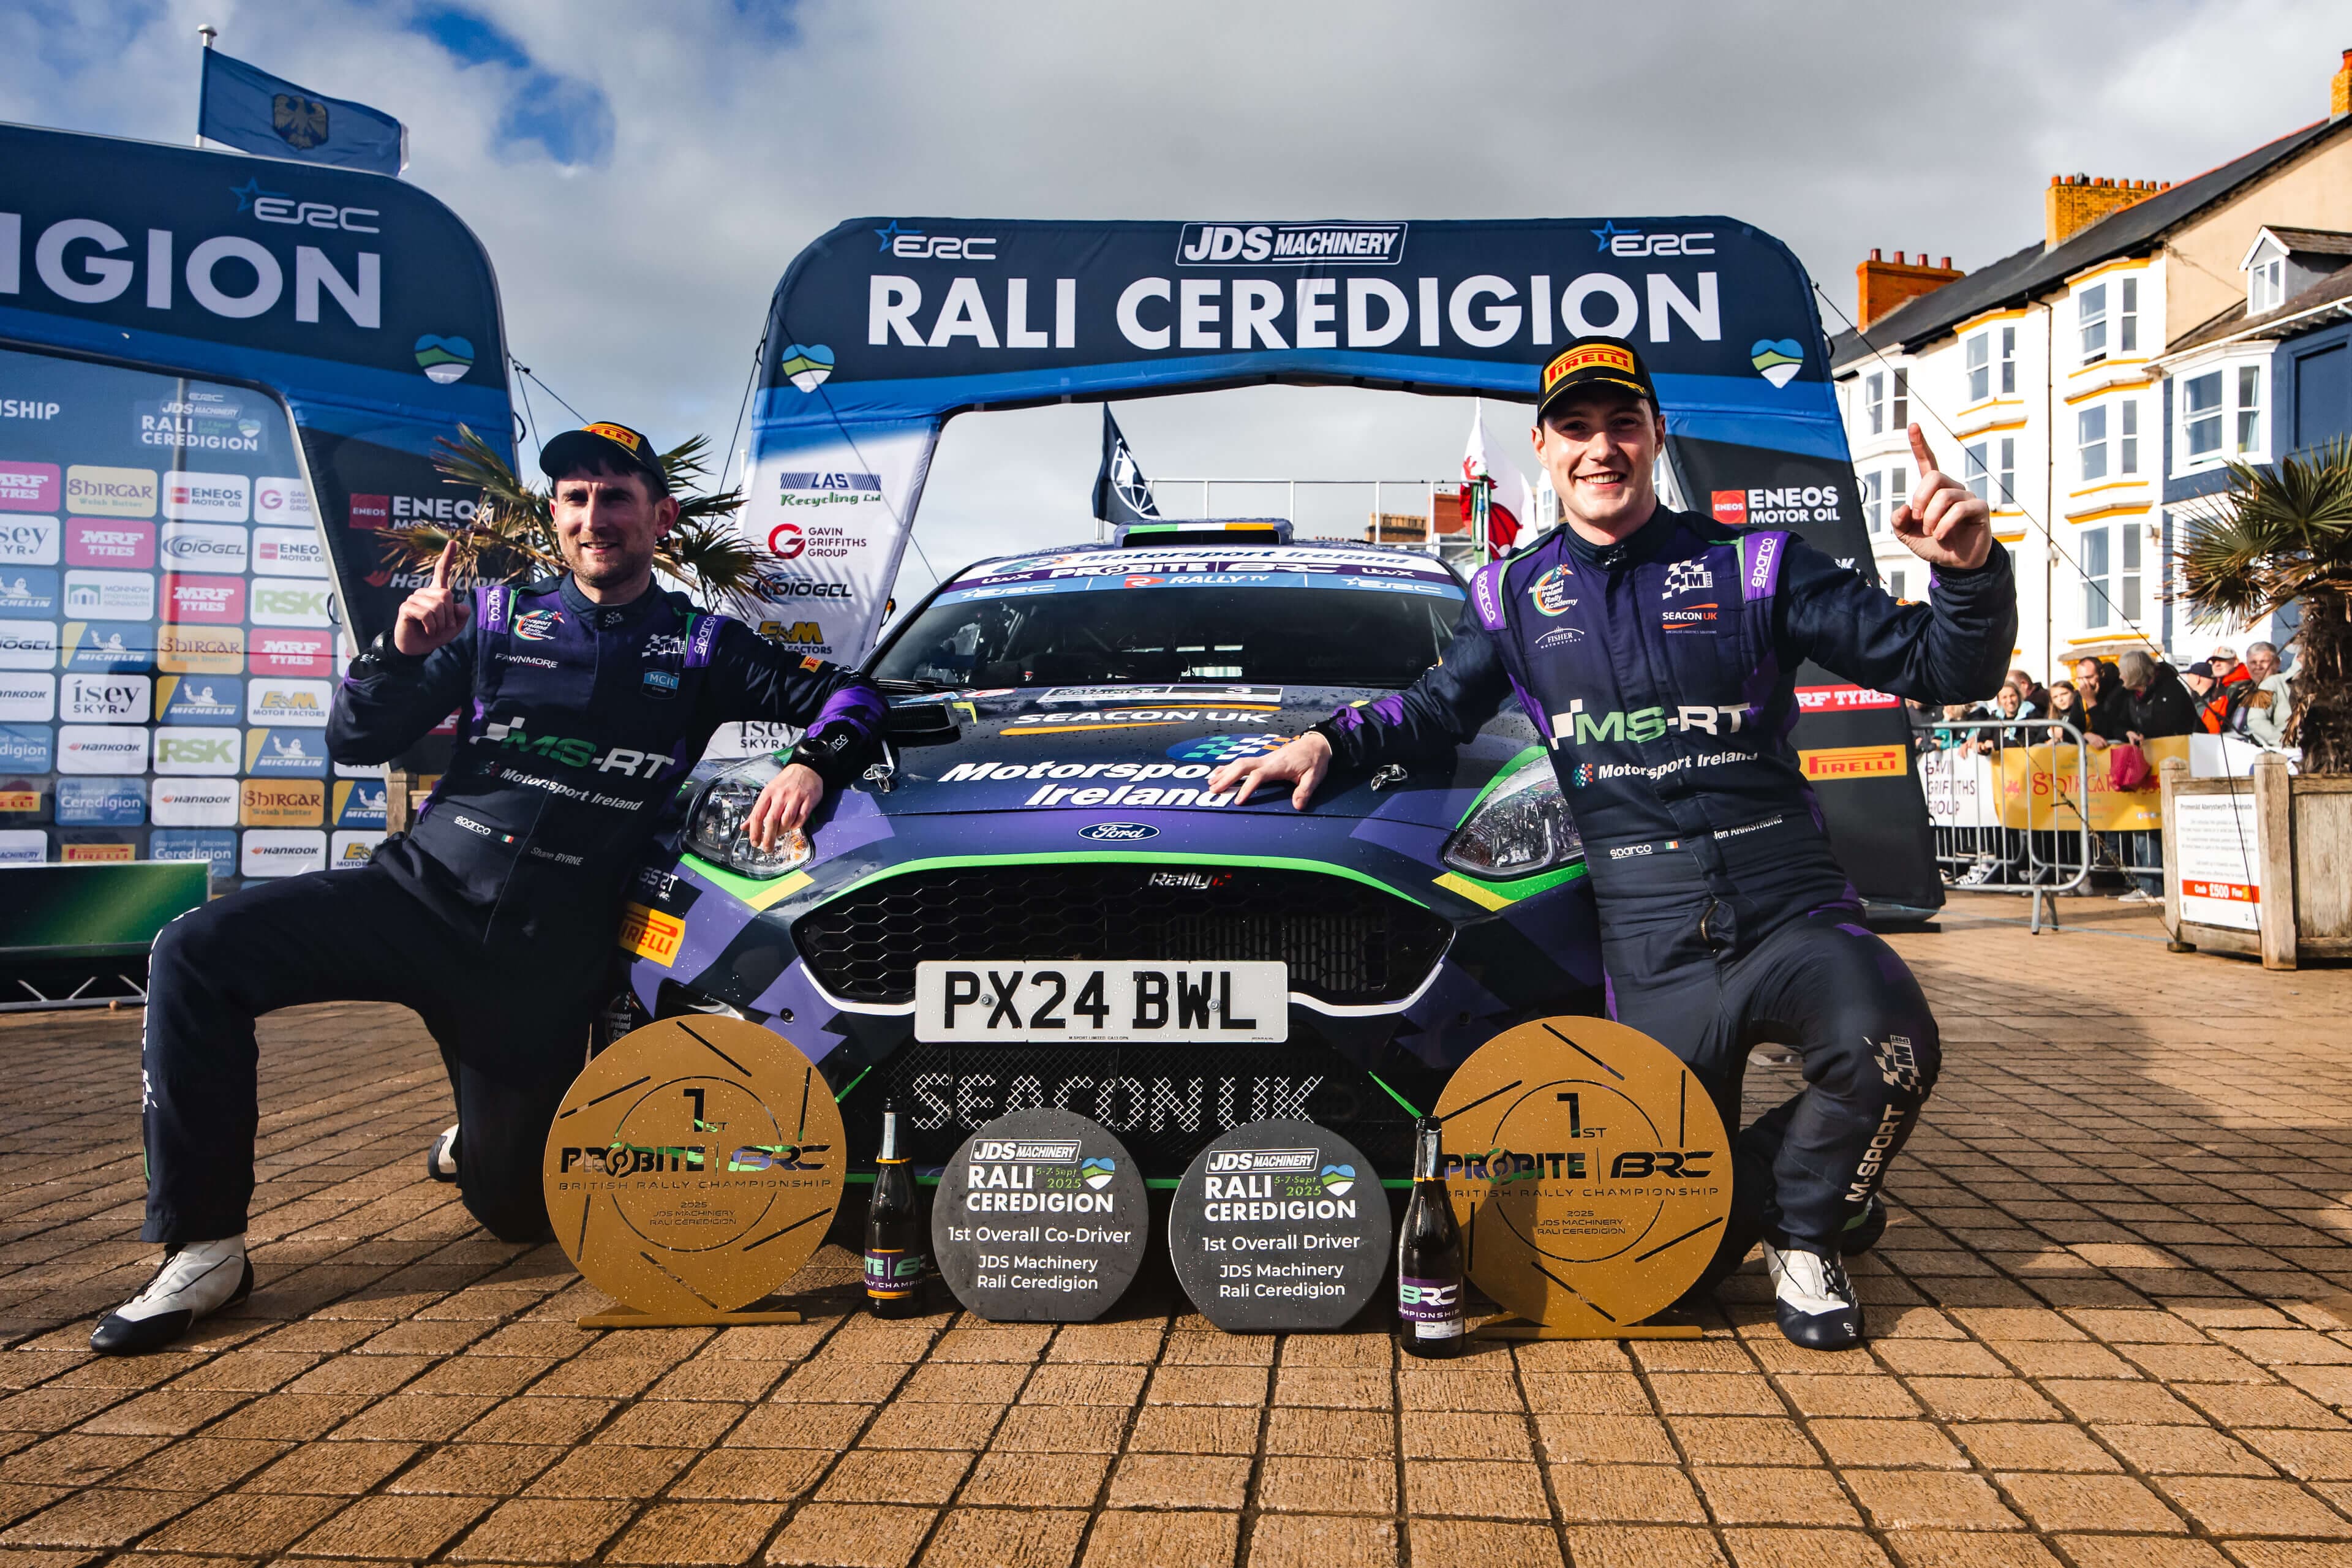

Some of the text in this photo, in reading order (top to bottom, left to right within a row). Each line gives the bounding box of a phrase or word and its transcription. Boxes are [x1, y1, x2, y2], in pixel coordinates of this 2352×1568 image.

[1185, 227, 1399, 261] JDS MACHINERY
[869, 271, 1722, 350] RALI CEREDIGION
[1549, 348, 1629, 383] PIRELLI
[0, 399, 60, 420] SHIP
[162, 402, 194, 415] JDS
[141, 415, 193, 432] RALI
[141, 431, 257, 451] CEREDIGION
[811, 473, 850, 488] LAS
[191, 488, 242, 500] ENEOS
[780, 492, 859, 507] Recycling
[1748, 486, 1838, 508] ENEOS
[352, 507, 386, 516] ENEOS
[1714, 502, 1744, 511] ENEOS
[1750, 508, 1841, 524] MOTOR OIL
[80, 530, 145, 545] MRF
[808, 527, 843, 536] GAVIN
[88, 545, 135, 556] TYRES
[280, 543, 320, 555] ENEO
[808, 538, 867, 548] GRIFFITHS
[808, 549, 848, 557] GROUP
[1080, 549, 1409, 564] Motorsport Ireland
[1049, 562, 1208, 579] PROBITE
[1751, 537, 1774, 589] sparco
[1528, 579, 1565, 594] Motorsport
[1687, 573, 1705, 587] M
[173, 586, 235, 601] MRF
[1476, 569, 1496, 623] sparco
[1541, 586, 1564, 598] Ireland
[1544, 595, 1562, 604] Rally
[181, 601, 226, 612] TYRES
[254, 589, 328, 616] RSK
[1544, 598, 1578, 609] Academy
[1662, 611, 1718, 620] SEACON UK
[694, 616, 717, 657] sparco
[1547, 631, 1574, 643] FISHER
[262, 640, 322, 654] MRF
[77, 652, 146, 662] MICHELIN
[270, 655, 314, 665] TYRES
[495, 652, 559, 669] FAWNMORE
[73, 704, 118, 714] SKYR
[170, 707, 236, 715] MICHELIN
[1014, 709, 1273, 725] SEACON UK
[157, 738, 236, 764] RSK
[740, 739, 780, 749] SKYR
[258, 758, 324, 767] MICHELIN
[1697, 749, 1758, 768] Ireland
[1809, 752, 1896, 775] PIRELLI
[938, 761, 1222, 783] Motorspo
[500, 767, 644, 811] Motorsport Ireland
[61, 796, 140, 810] Ceredigion
[453, 815, 491, 835] sparco
[1096, 824, 1147, 840] Ford
[154, 847, 232, 861] Ceredigion
[1610, 843, 1652, 859] sparco
[554, 853, 584, 866] BYRNE
[944, 971, 1257, 1030] PX24 BWL
[912, 1073, 1325, 1133] SEACON UK
[561, 1141, 707, 1178] PROBITE
[727, 1144, 832, 1172] BRC
[974, 1142, 1077, 1161] JDS MACHINERY
[1210, 1153, 1315, 1171] JDS MACHINERY
[1444, 1148, 1587, 1186] PROBITE
[1609, 1150, 1716, 1179] BRC
[967, 1165, 1033, 1189] RALI
[1055, 1167, 1077, 1177] Sept
[559, 1178, 832, 1191] BRITISH RALLY CHAMPIONSHIP
[1046, 1178, 1082, 1189] 2025
[1205, 1175, 1272, 1200] RALI
[1294, 1175, 1317, 1186] Sept
[1286, 1185, 1322, 1196] 2025
[1520, 1188, 1574, 1198] RALLY
[1582, 1188, 1720, 1197] CHAMPIONSHIP
[966, 1193, 1114, 1213] CEREDIGION
[1204, 1199, 1357, 1222] CEREDIGION
[1562, 1218, 1624, 1226] MACHINERY
[948, 1225, 1132, 1243] 1st Overall Co-Driver
[1202, 1232, 1361, 1252] 1st Overall Driver
[978, 1255, 1099, 1273] JDS Machinery
[1219, 1262, 1344, 1280] JDS Machinery
[977, 1274, 1099, 1292] Rali Ceredigion
[1219, 1282, 1346, 1299] Rali Ceredigion
[1400, 1284, 1458, 1306] BRC
